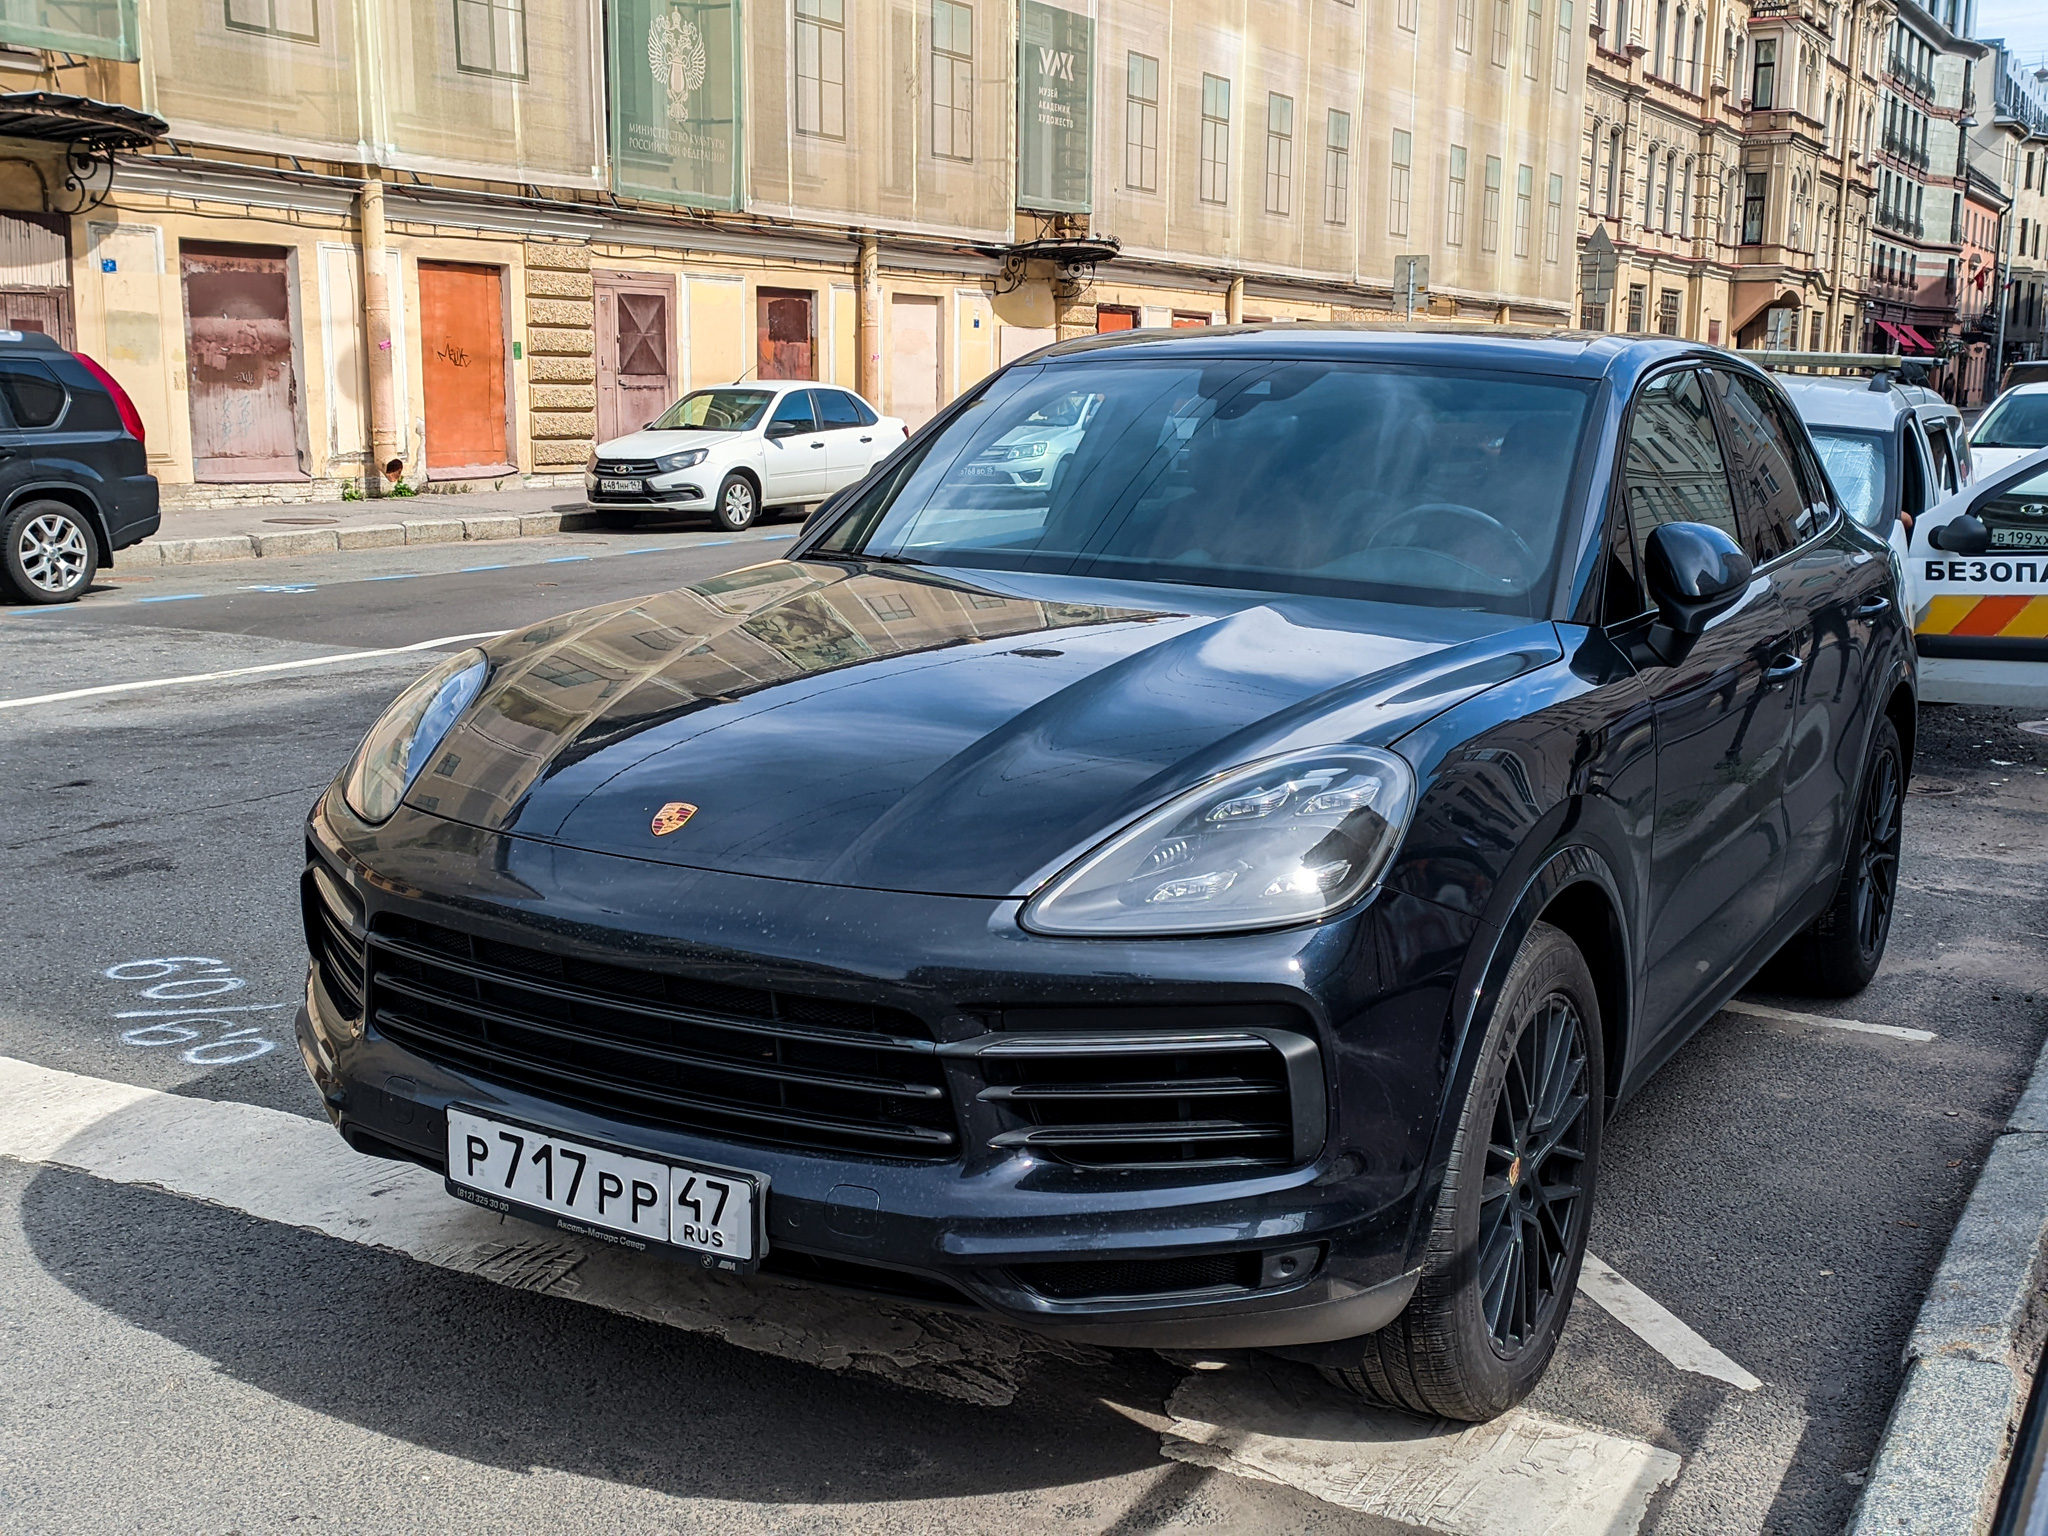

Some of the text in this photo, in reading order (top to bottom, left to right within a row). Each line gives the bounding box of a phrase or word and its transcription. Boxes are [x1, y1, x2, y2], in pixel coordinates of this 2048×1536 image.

[1038, 86, 1058, 99] МУЗЕЙ
[1038, 113, 1074, 129] ХУДОЖЕСТВ
[628, 122, 726, 149] МИНИСТЕРСТВО КУЛЬТУРЫ
[628, 137, 726, 163] РОССИЙСКОЙ ФЕДЕРАЦИИ
[678, 1177, 730, 1227] 47
[556, 1219, 647, 1251] Аксель-Моторс Север
[684, 1223, 725, 1248] RUS
